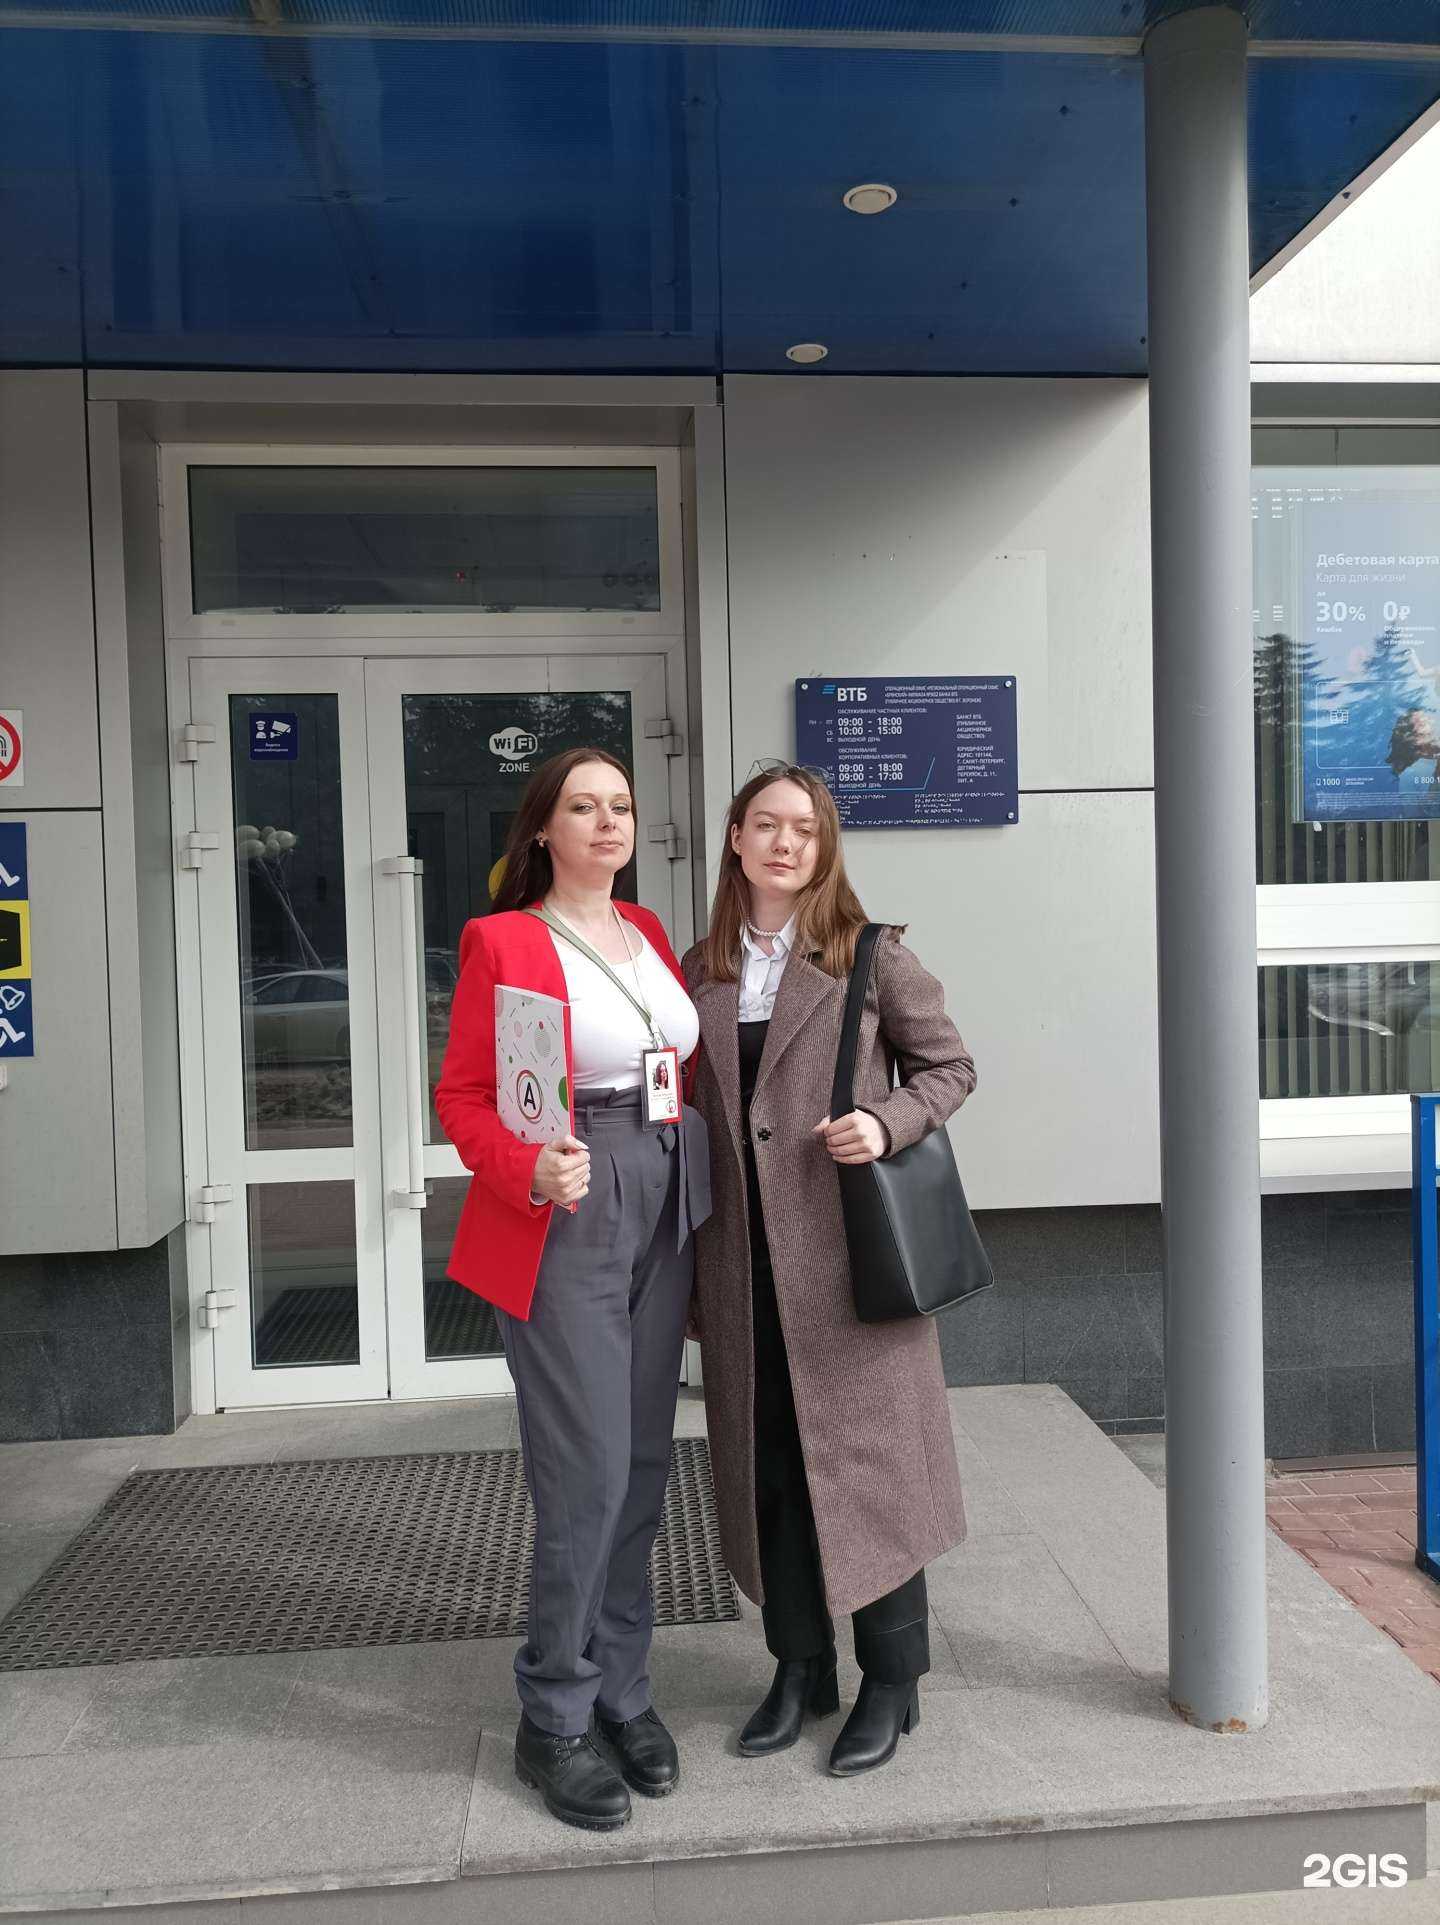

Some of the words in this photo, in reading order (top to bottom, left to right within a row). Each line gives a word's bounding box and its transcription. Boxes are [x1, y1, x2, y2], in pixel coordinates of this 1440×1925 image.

[1316, 553, 1395, 568] Дебетовая
[1398, 555, 1440, 568] карта
[1316, 573, 1346, 584] Карта
[1348, 574, 1369, 583] для
[1316, 601, 1366, 622] 30%
[837, 687, 868, 702] ВТБ
[838, 718, 863, 726] 09:00
[877, 717, 902, 726] 18:00
[839, 727, 863, 735] 10:00
[877, 726, 902, 735] 15:00
[499, 762, 531, 773] ZONE
[838, 764, 864, 772] 09:00
[878, 763, 903, 771] 18:00
[838, 773, 864, 781] 09:00
[878, 772, 903, 780] 17:00
[1323, 778, 1341, 786] 1000
